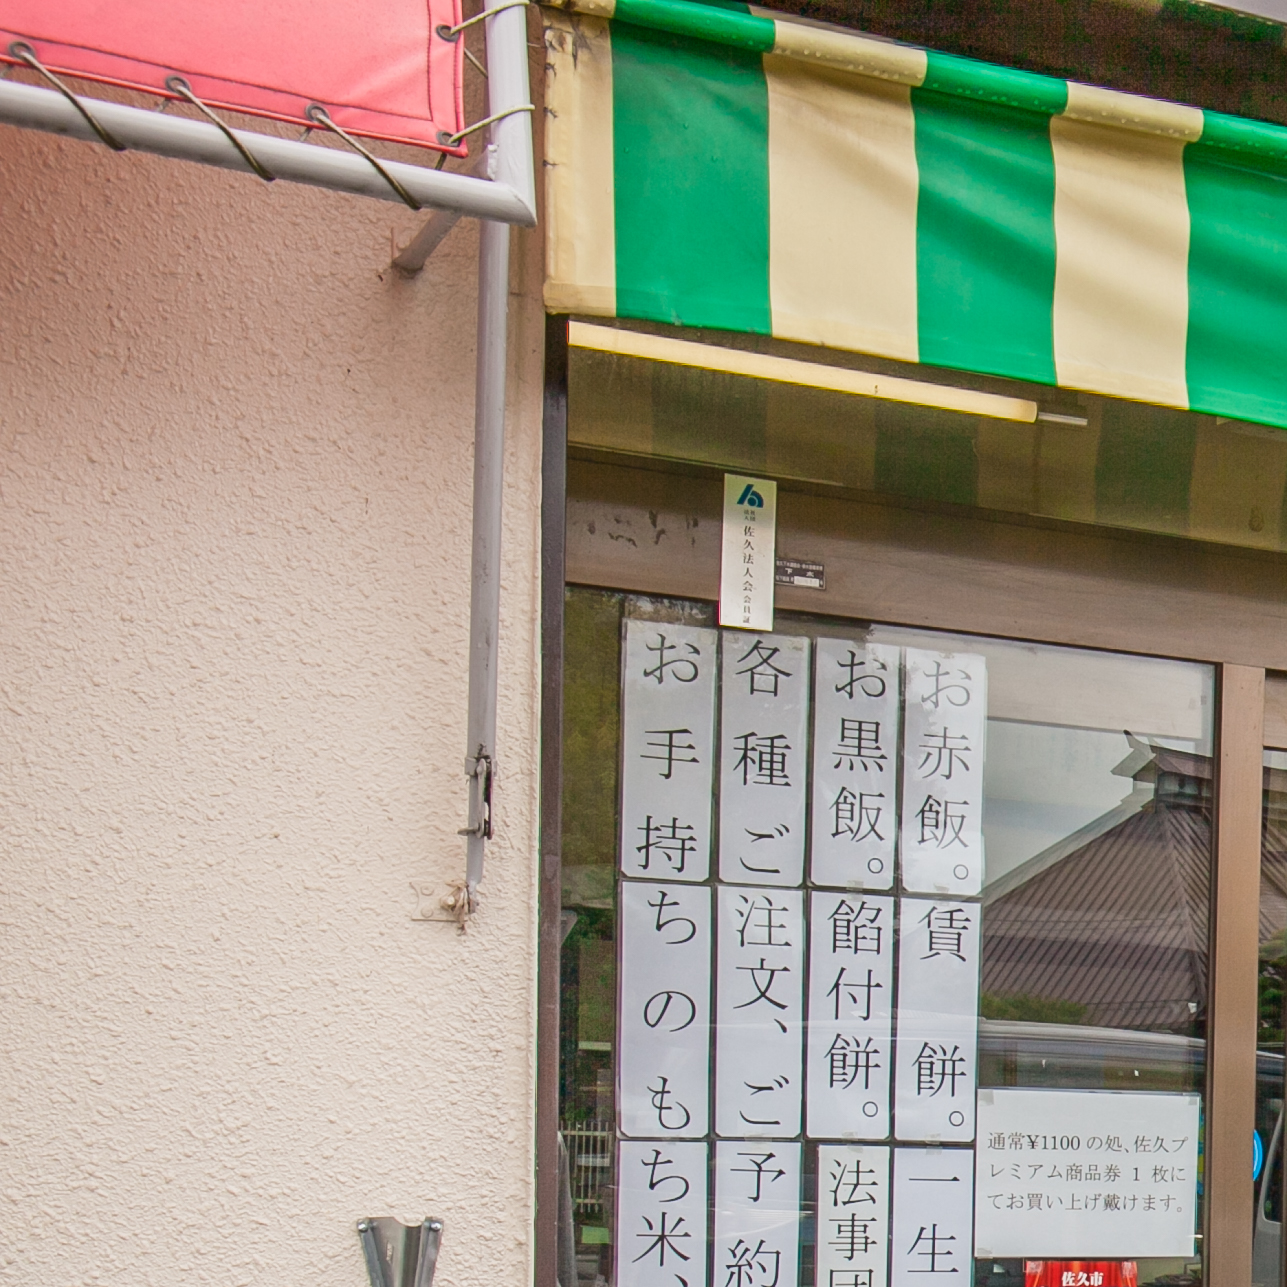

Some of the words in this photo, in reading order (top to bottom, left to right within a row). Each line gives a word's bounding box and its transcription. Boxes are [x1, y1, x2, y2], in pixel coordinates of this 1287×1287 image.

[742, 525, 755, 592] 佐久法人会
[829, 649, 888, 876] お黒飯。
[914, 660, 972, 882] お赤飯。
[823, 899, 884, 1119] 餡付餅。
[910, 906, 969, 1128] 賃餅。
[990, 1163, 1121, 1182] レミアム商品券
[1061, 1272, 1104, 1287] 佐久市
